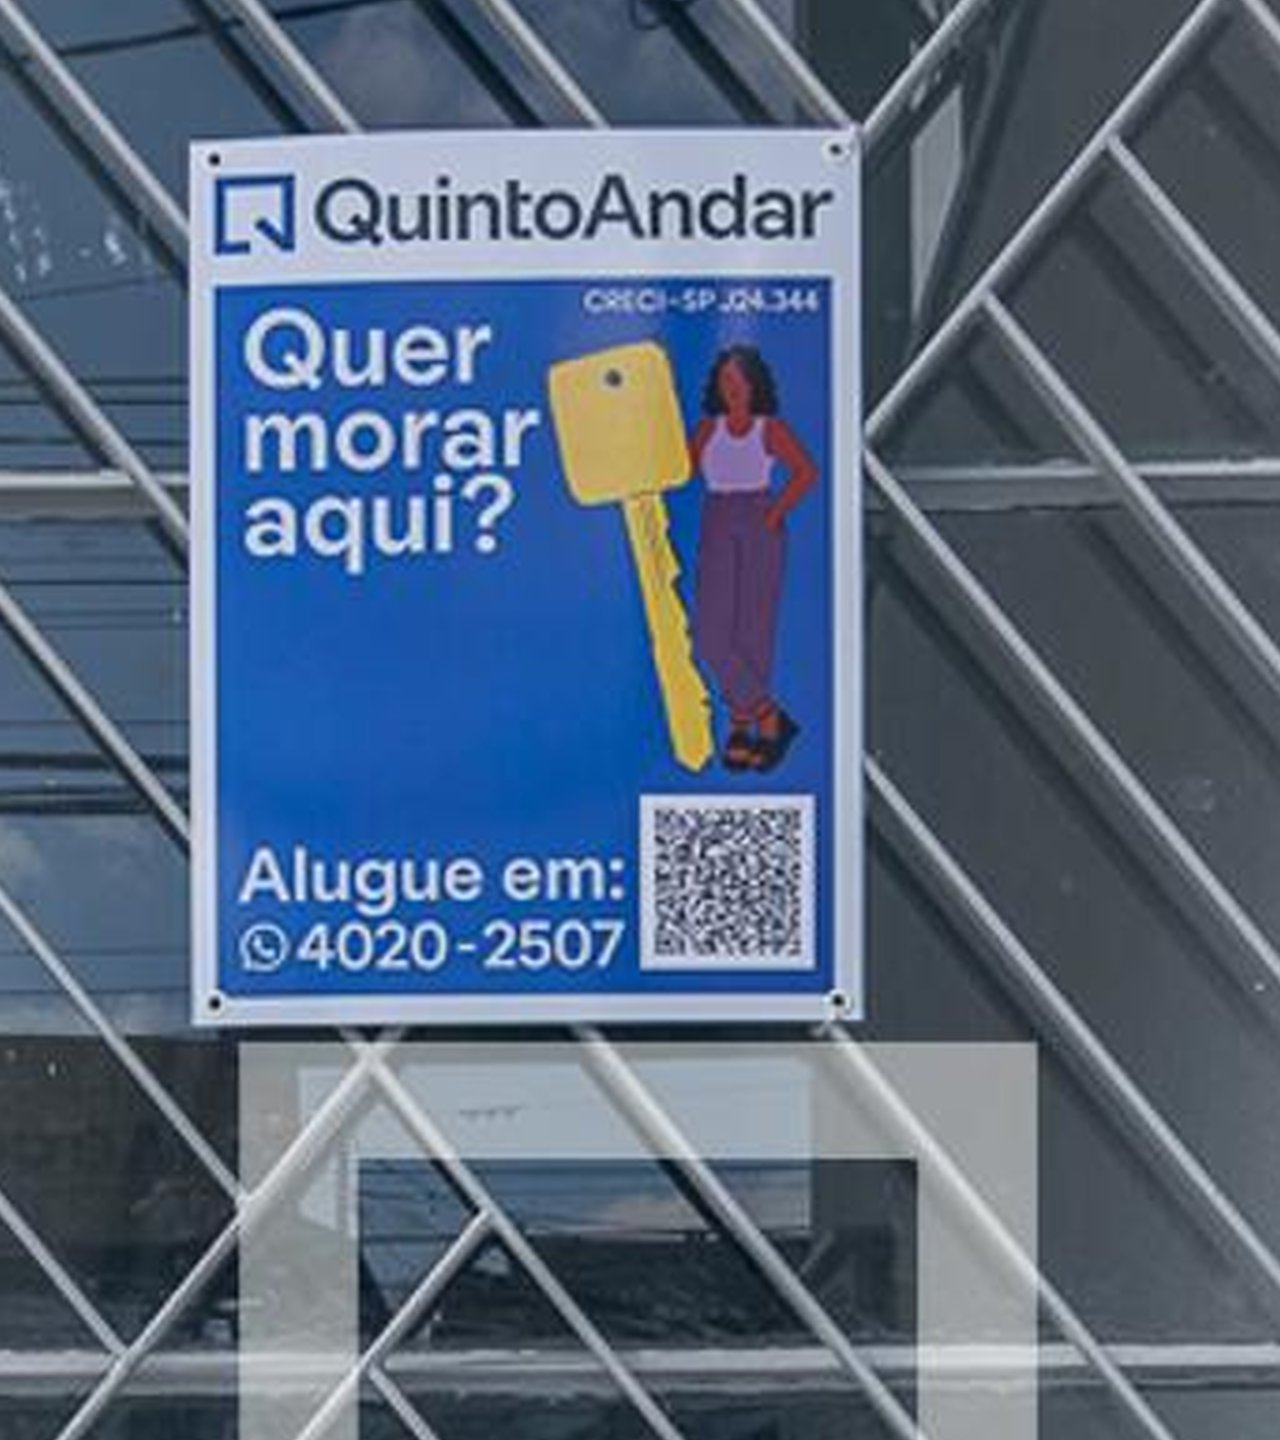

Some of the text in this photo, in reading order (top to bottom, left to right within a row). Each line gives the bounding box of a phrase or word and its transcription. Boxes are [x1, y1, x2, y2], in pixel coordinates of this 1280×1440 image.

[315, 173, 834, 246] QuintoAndar
[583, 287, 716, 313] CRECI-SP
[244, 306, 492, 391] Quer
[245, 407, 540, 472] morar
[243, 473, 516, 575] aqui?
[238, 845, 627, 917] Alugue em:
[297, 919, 626, 972] 4020-2507
